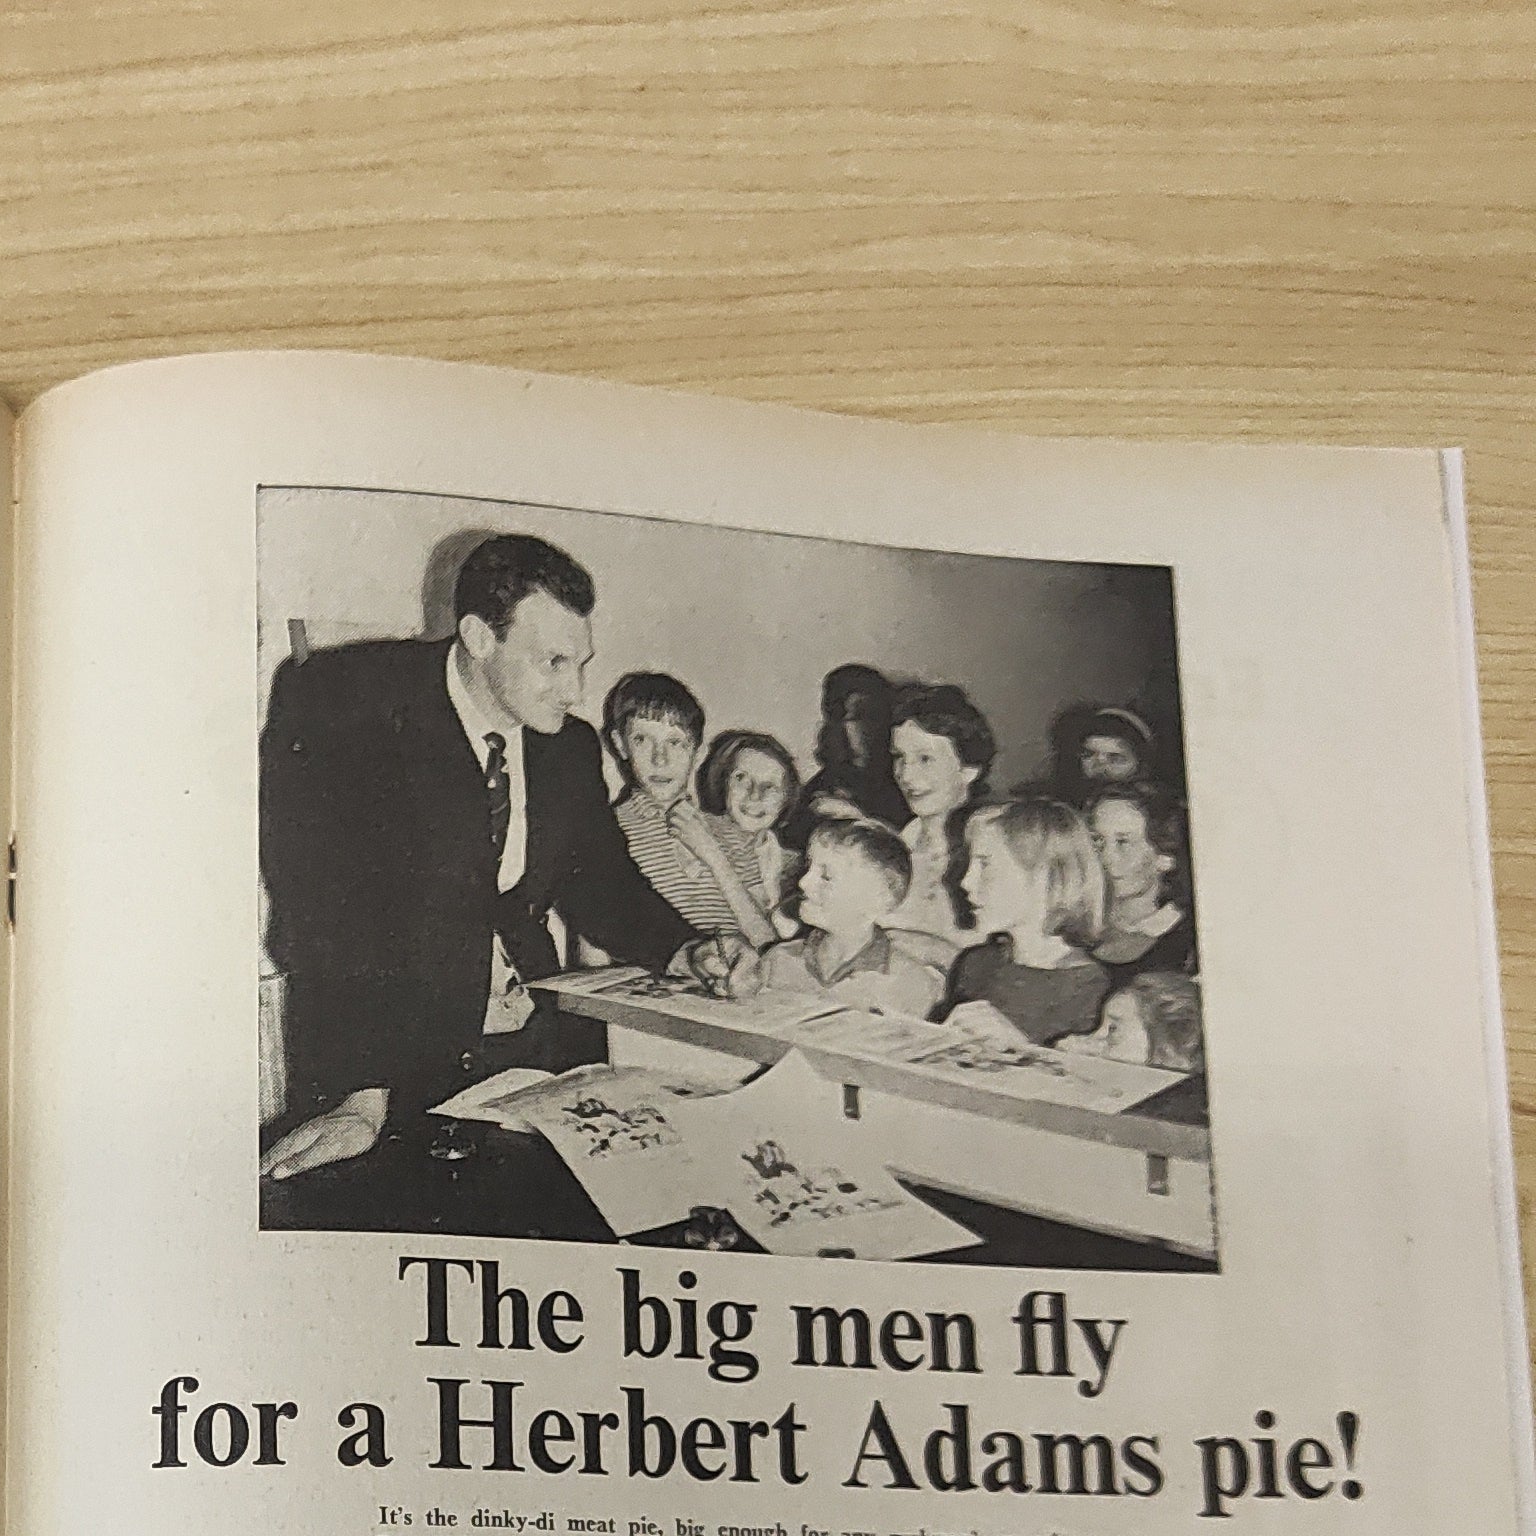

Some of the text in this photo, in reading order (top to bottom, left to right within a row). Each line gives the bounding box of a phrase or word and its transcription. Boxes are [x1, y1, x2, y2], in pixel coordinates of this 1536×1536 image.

[398, 1256, 1128, 1397] The big men fly
[151, 1376, 1364, 1518] for a Herbert Adams pie!
[379, 1506, 412, 1528] It's
[426, 1507, 458, 1527] the
[471, 1508, 554, 1532] dinky-di
[567, 1519, 616, 1533] meat
